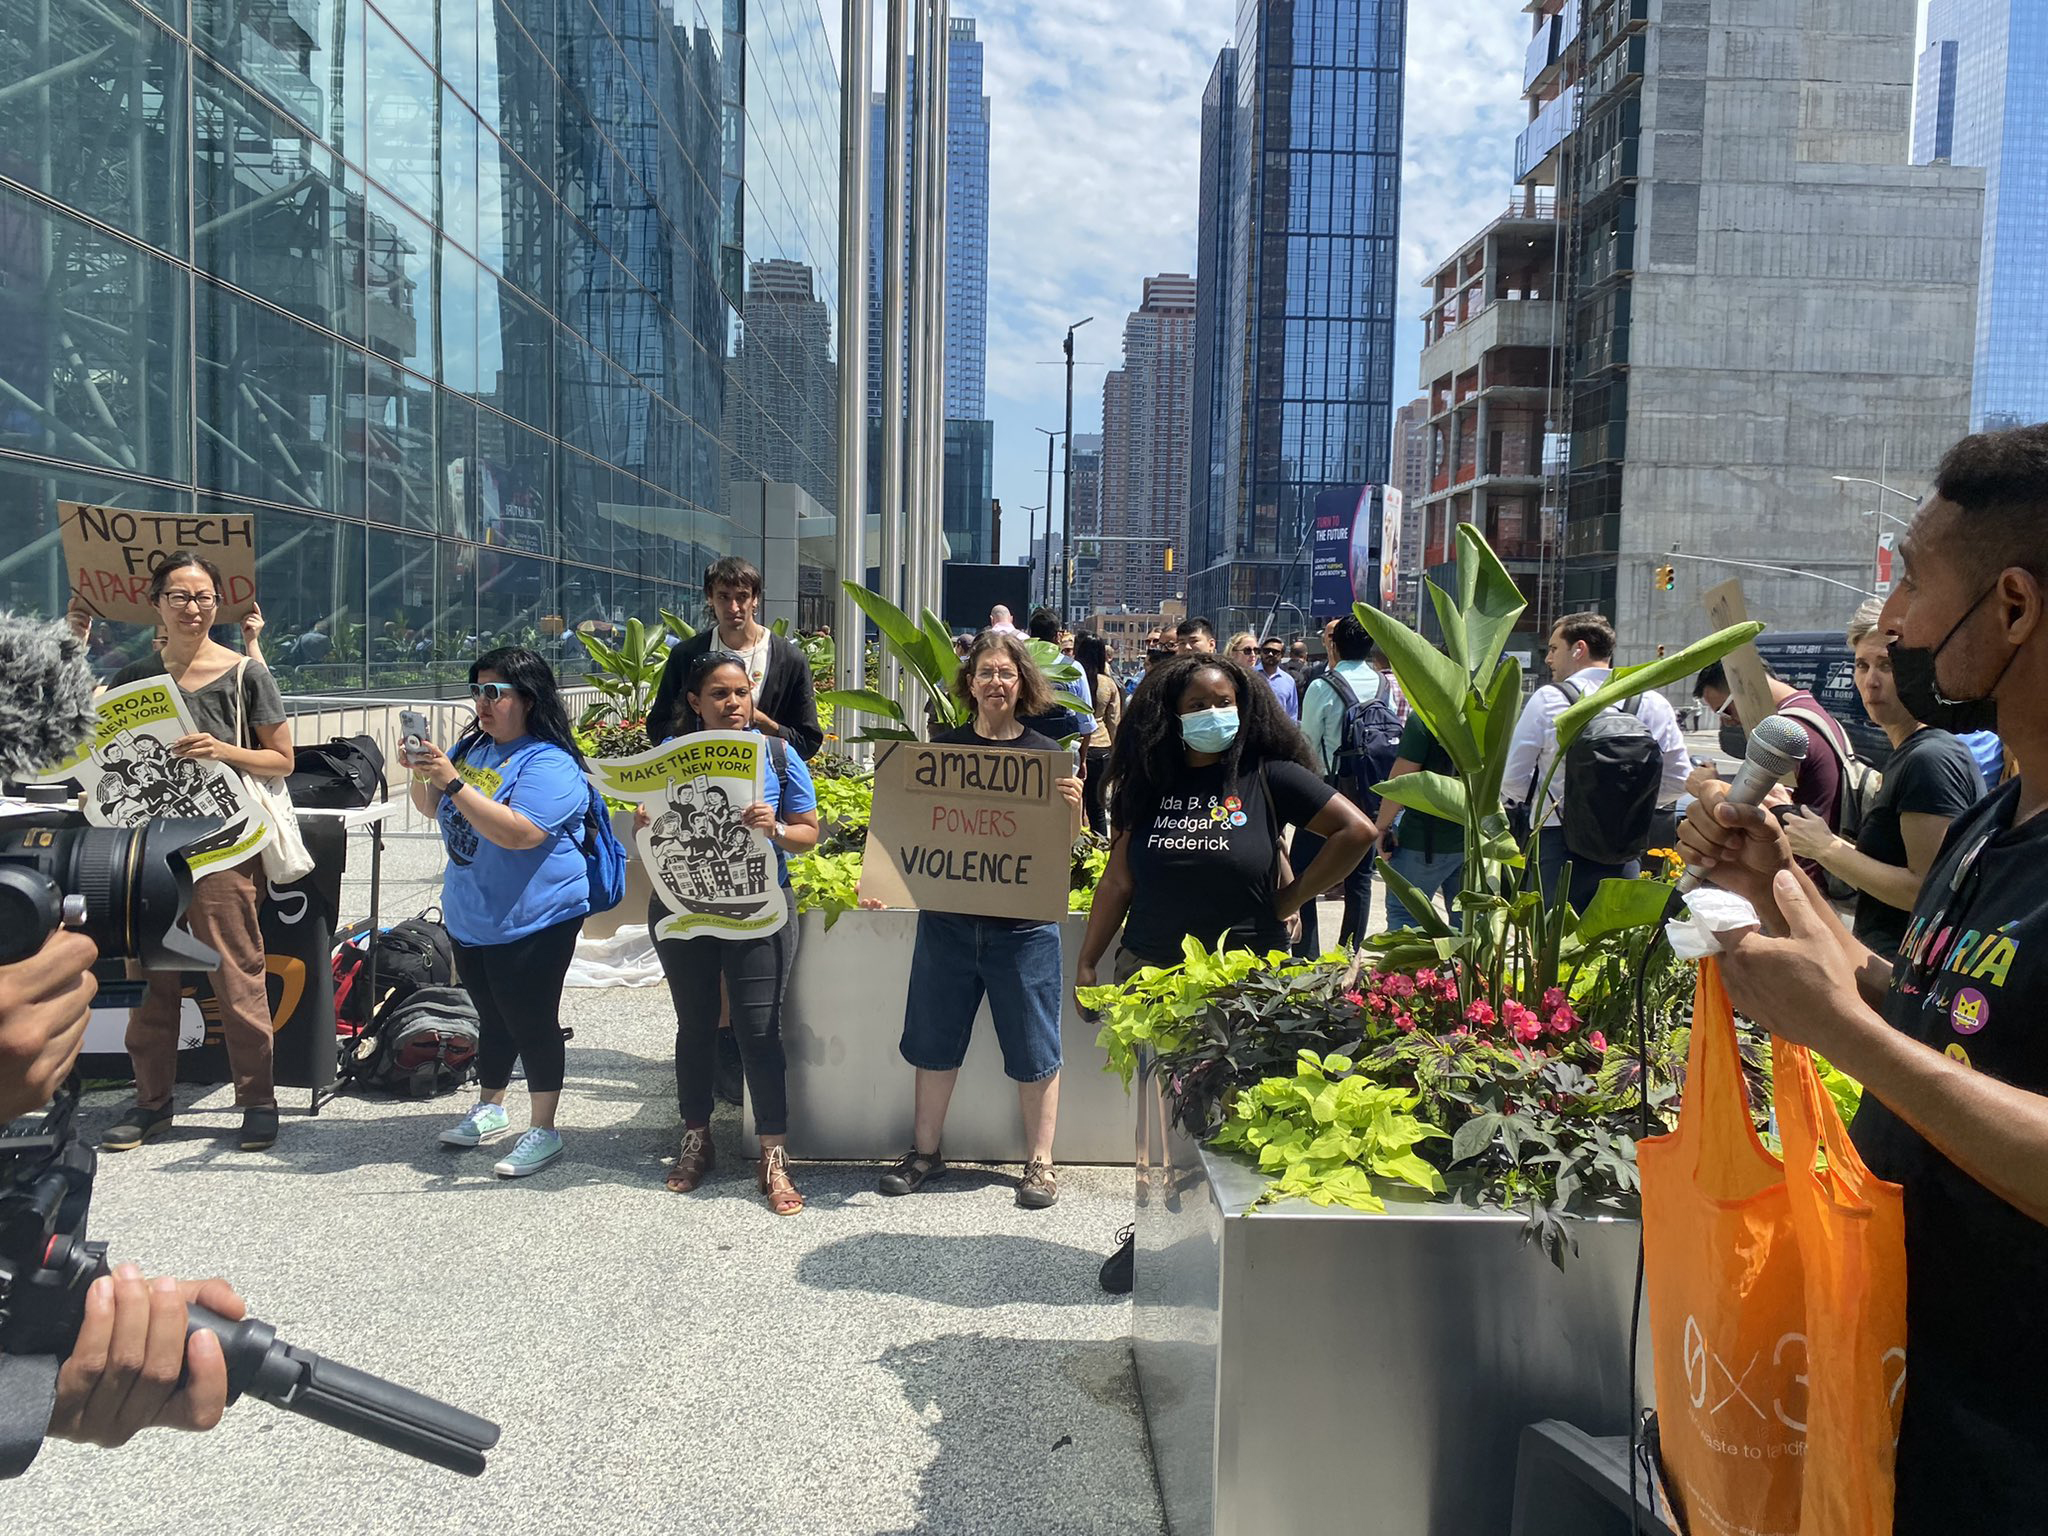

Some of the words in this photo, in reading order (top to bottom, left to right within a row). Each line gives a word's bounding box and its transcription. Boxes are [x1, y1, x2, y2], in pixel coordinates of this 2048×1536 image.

[77, 506, 137, 543] NO
[140, 516, 252, 548] TECH
[1316, 530, 1326, 541] THE
[1327, 528, 1348, 540] FUTURE
[122, 546, 168, 576] FO
[112, 692, 165, 714] ROAD
[98, 716, 128, 738] NEW
[131, 704, 169, 720] YORK
[620, 762, 667, 782] MAKE
[667, 748, 701, 768] THE
[705, 746, 752, 759] ROAD
[681, 761, 712, 776] NEW
[716, 761, 751, 773] YORK
[915, 751, 1043, 798] amazon
[1160, 796, 1182, 810] Ida
[1187, 796, 1202, 810] B.
[1207, 795, 1218, 809] &
[932, 806, 1017, 838] POWERS
[1154, 816, 1215, 832] Medgar
[1220, 817, 1232, 830] &
[1147, 834, 1230, 850] Frederick
[901, 846, 1032, 885] VIOLENCE
[1743, 1444, 1761, 1460] to
